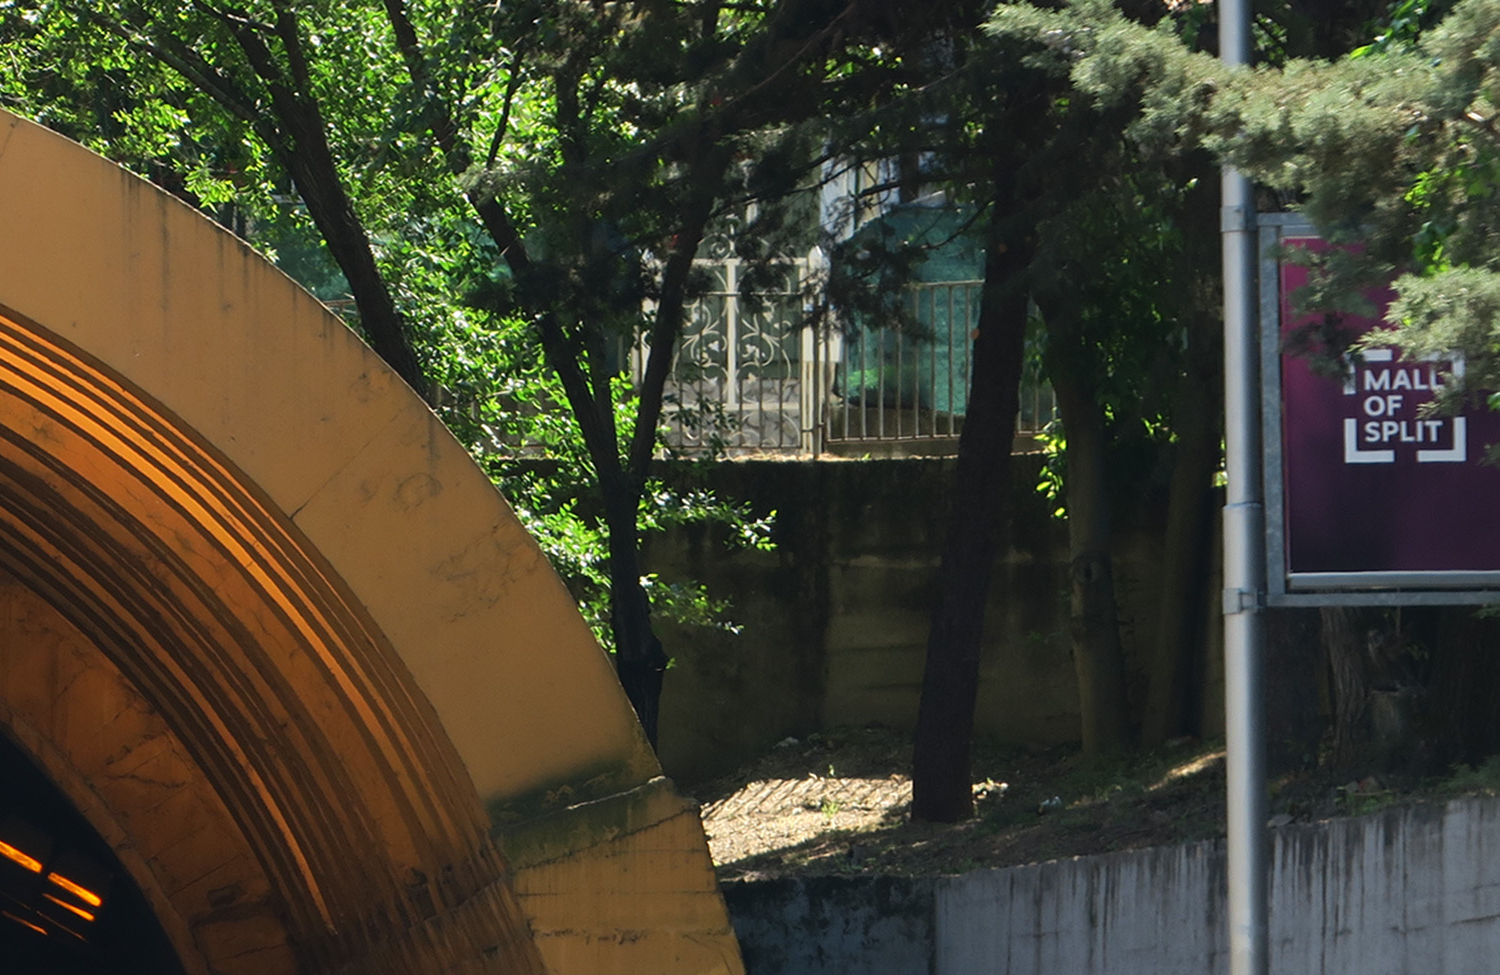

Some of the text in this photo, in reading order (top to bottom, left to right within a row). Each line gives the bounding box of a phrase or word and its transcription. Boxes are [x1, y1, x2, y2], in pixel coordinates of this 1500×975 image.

[1364, 369, 1445, 391] MALL
[1363, 395, 1403, 416] OF
[1364, 421, 1443, 442] SPLIT
